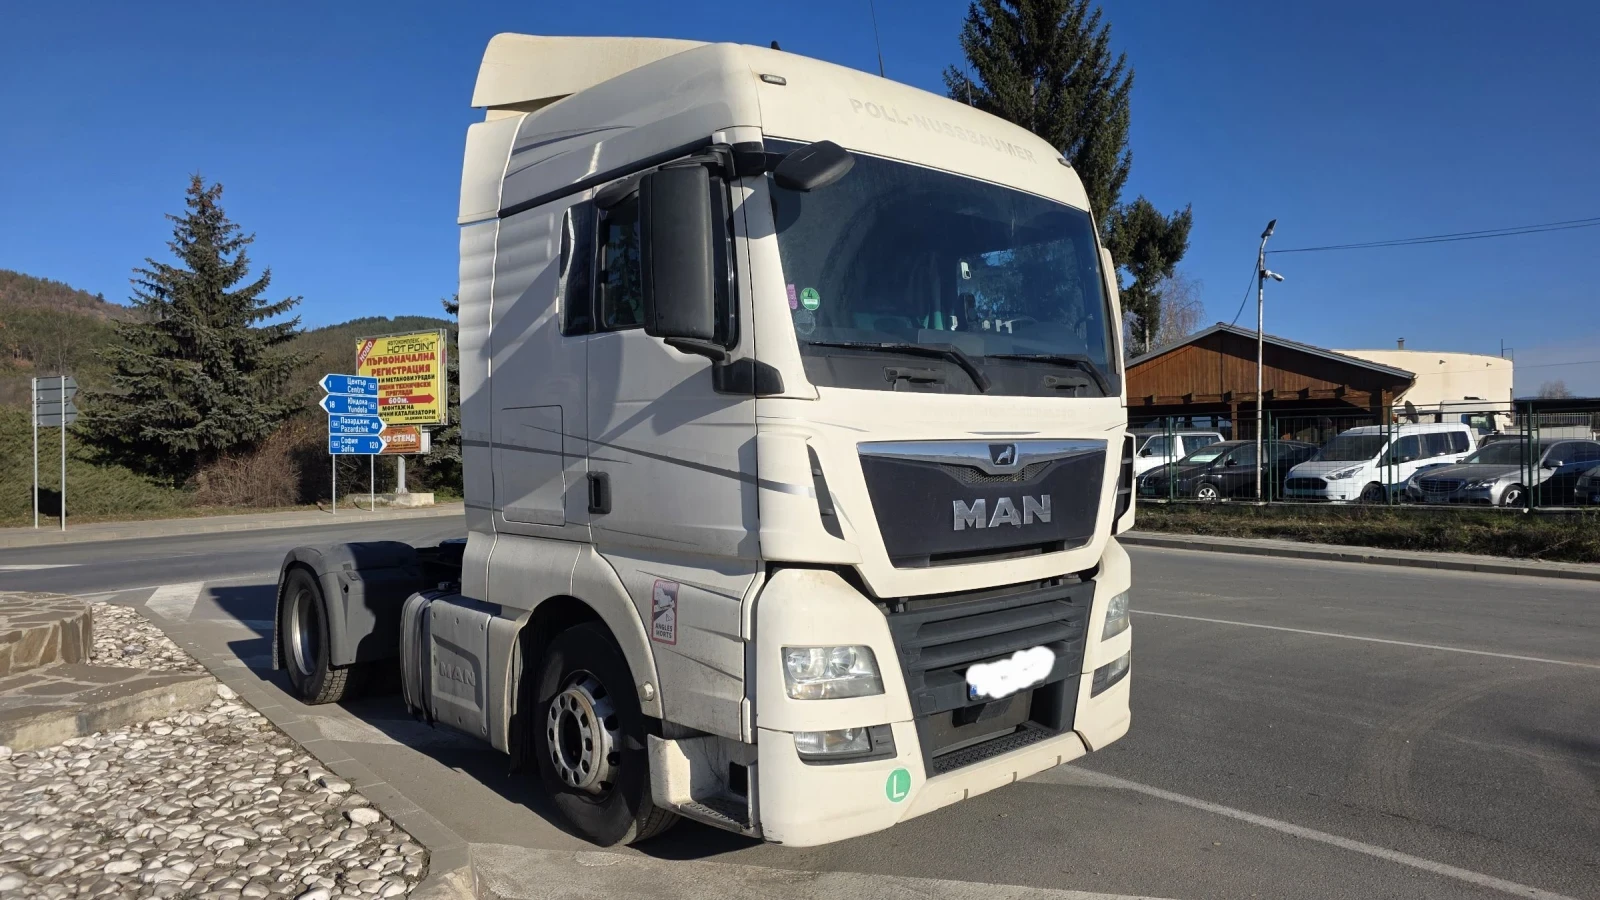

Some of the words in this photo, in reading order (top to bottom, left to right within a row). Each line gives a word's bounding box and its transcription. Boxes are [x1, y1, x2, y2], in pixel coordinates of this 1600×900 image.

[360, 341, 373, 361] НОВО
[387, 345, 406, 354] HOT
[408, 342, 435, 352] POINT
[366, 352, 435, 366] ПЪРВОНАЧАЛНА
[372, 364, 430, 376] РЕГИСТРАЦИЯ
[347, 378, 366, 387] Център
[348, 397, 367, 405] Юндола
[341, 417, 370, 425] Пазарджик
[393, 434, 416, 442] СТЕНД
[952, 494, 1052, 530] MAN
[655, 623, 672, 632] ANGLES
[439, 661, 476, 687] MAN
[893, 774, 904, 798] L
